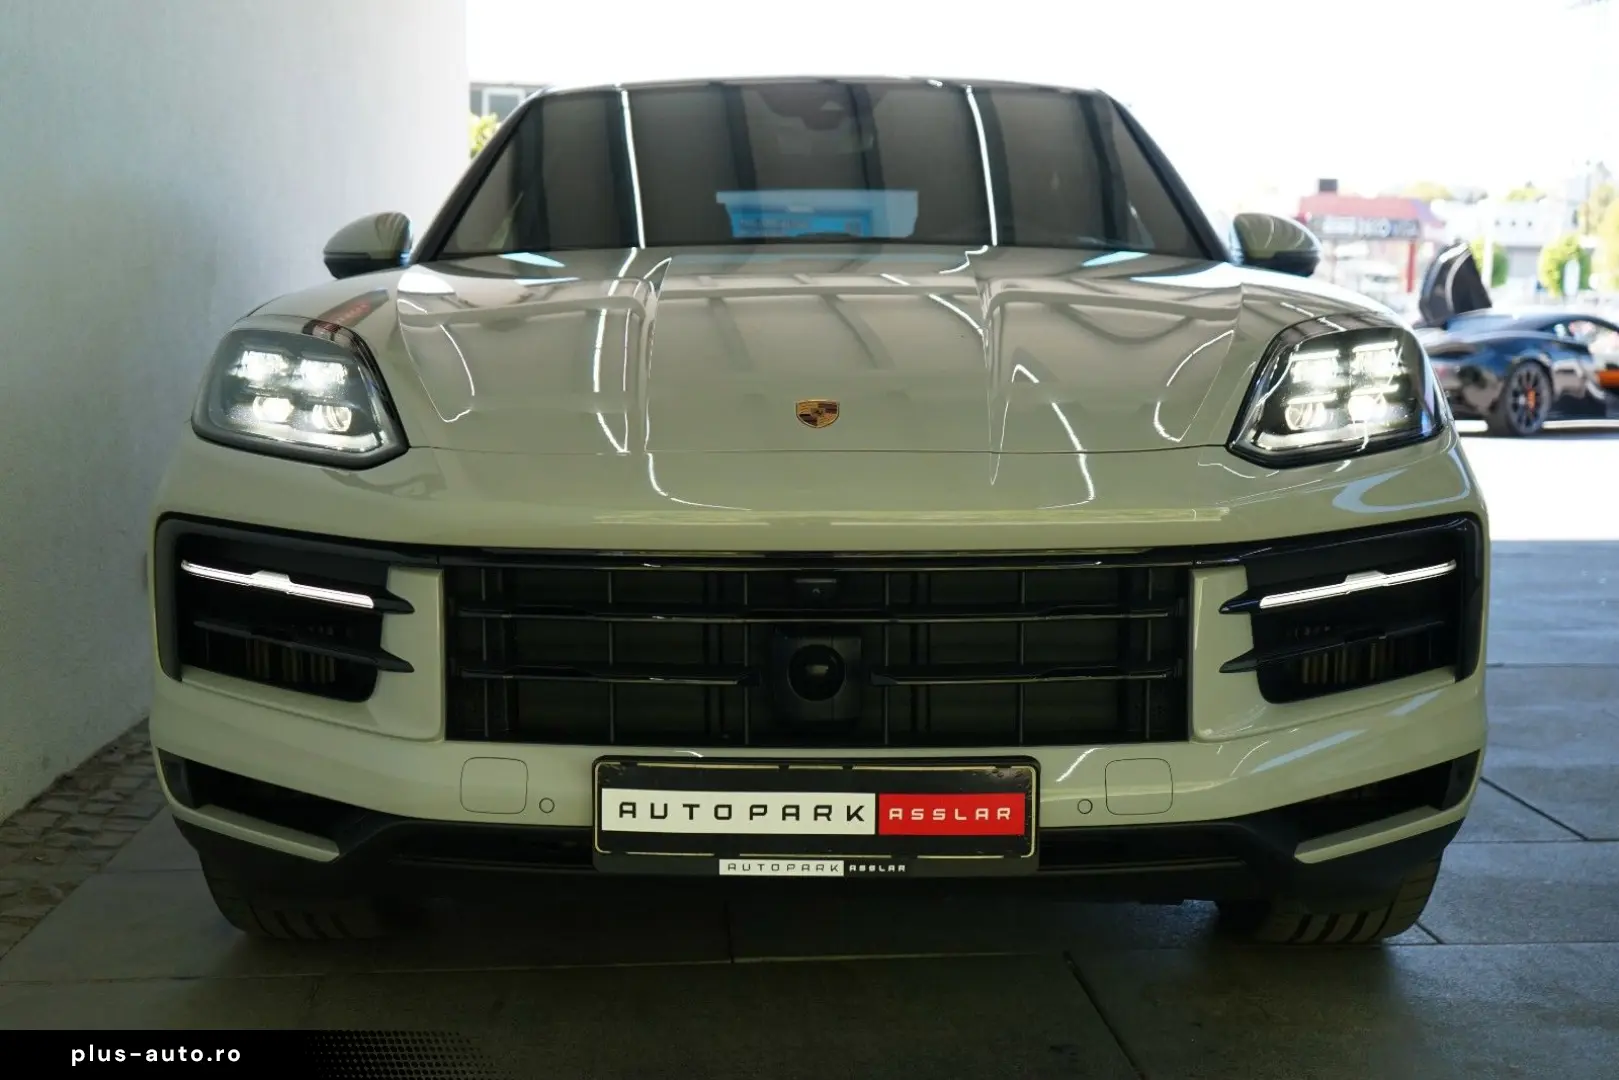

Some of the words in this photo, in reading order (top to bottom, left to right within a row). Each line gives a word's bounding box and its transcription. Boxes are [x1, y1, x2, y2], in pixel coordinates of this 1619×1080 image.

[618, 801, 866, 822] AUTOPARK
[888, 807, 1012, 821] ASSLAR
[726, 863, 840, 873] AUTOPARK
[848, 864, 906, 872] ASSLAR
